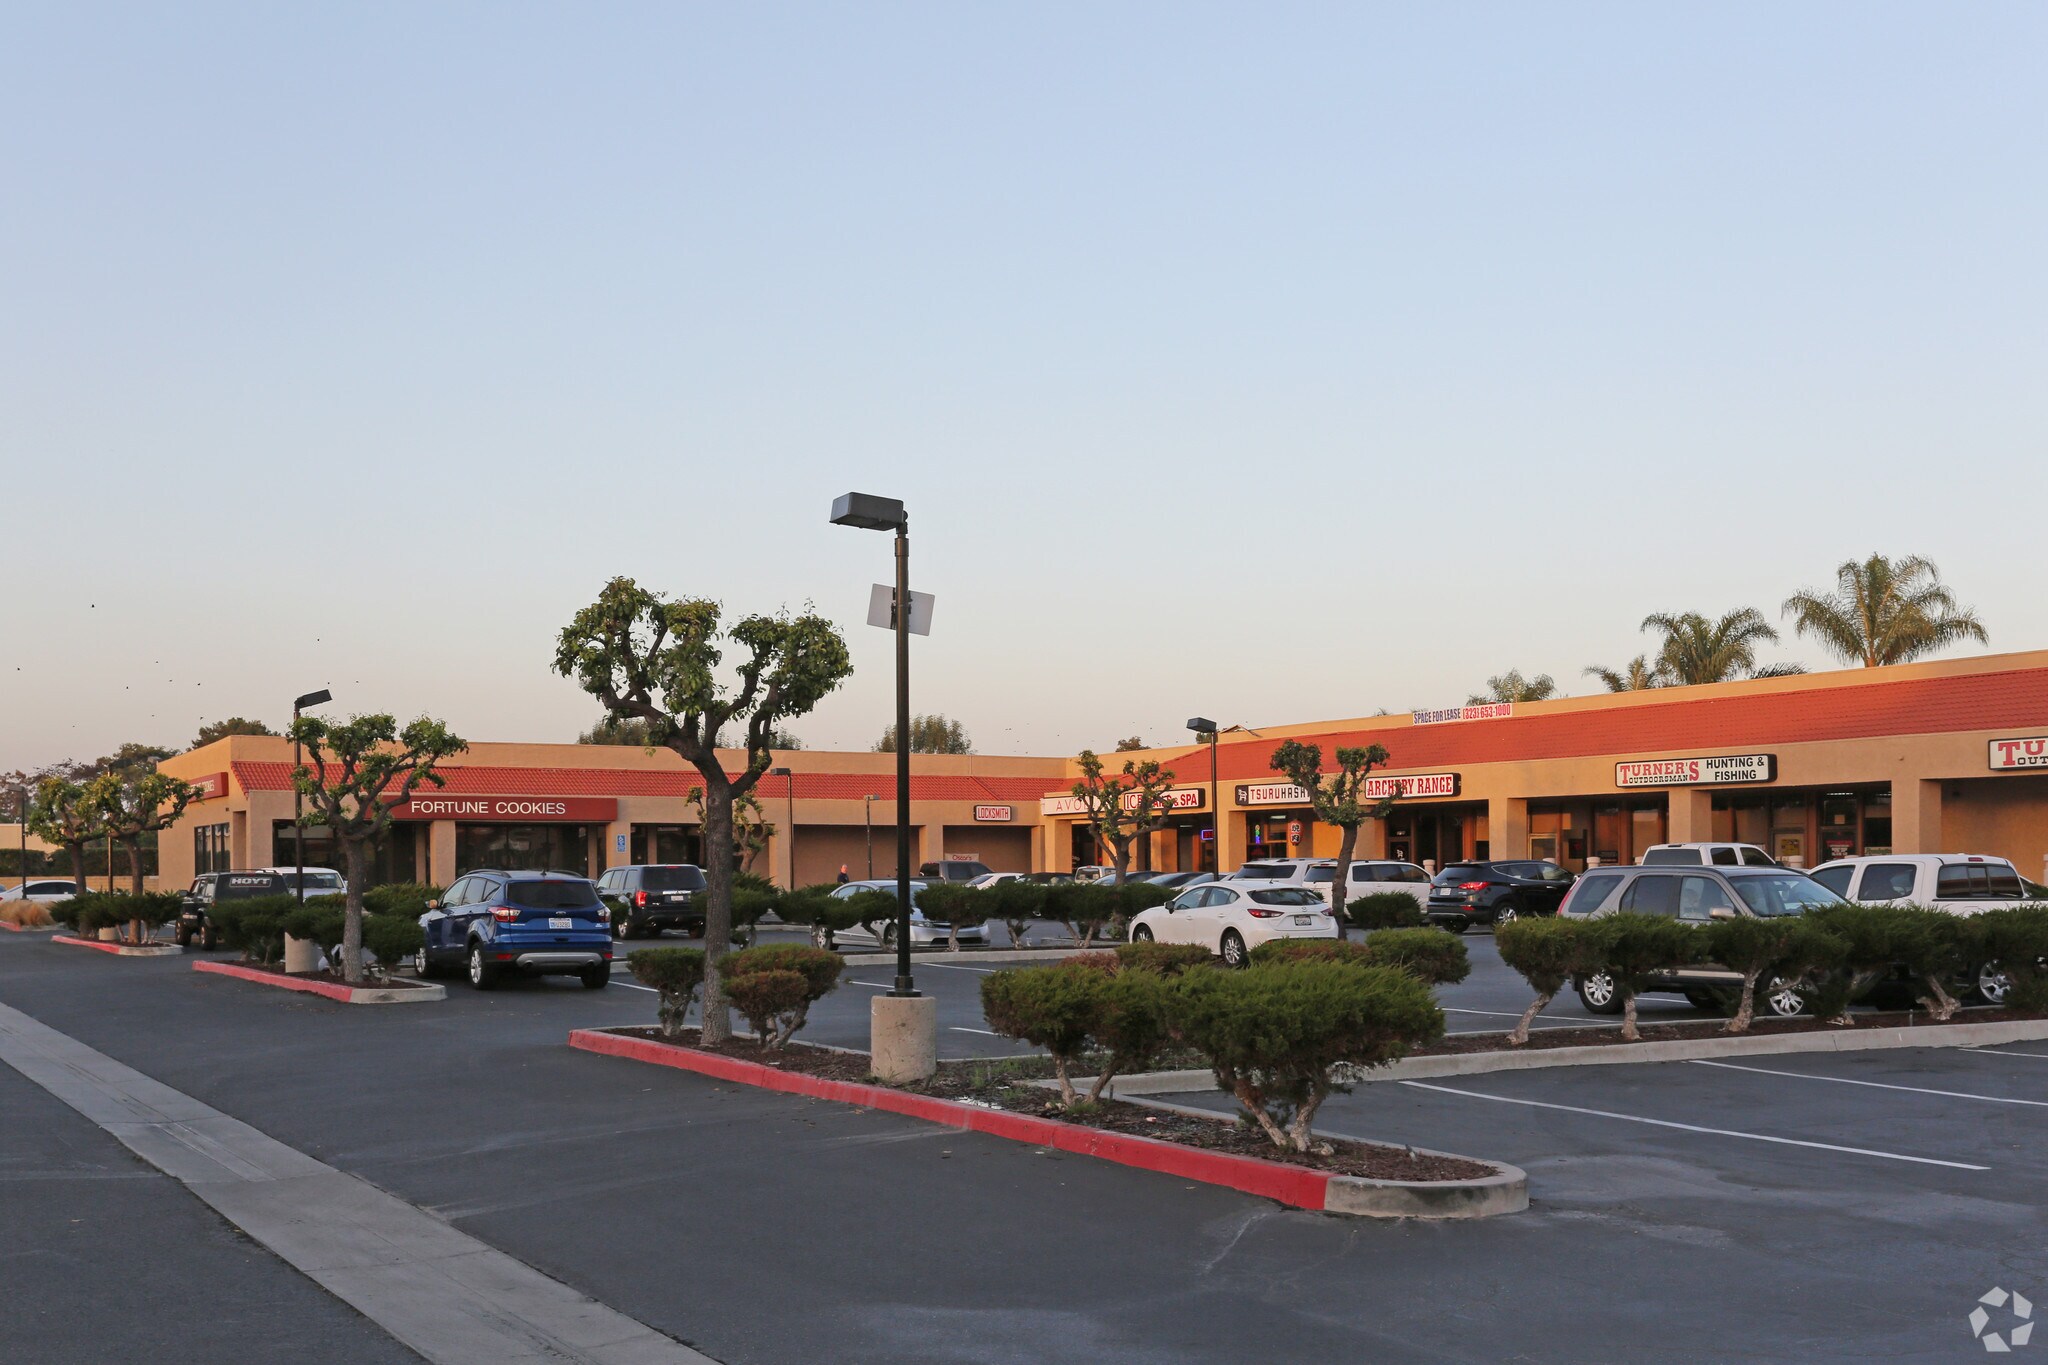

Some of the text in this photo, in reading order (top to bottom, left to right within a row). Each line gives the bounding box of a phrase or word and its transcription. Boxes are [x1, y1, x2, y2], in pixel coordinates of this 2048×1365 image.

[1414, 711, 1432, 724] SPACE
[1433, 710, 1444, 722] FOR
[1444, 708, 1461, 720] LEASE
[1480, 704, 1511, 718] 653-1000
[1706, 756, 1765, 769] HUNTING &
[1620, 761, 1699, 784] TURNER'S
[1628, 774, 1688, 784] OUTDOORSMAN
[1714, 769, 1757, 781] FISHING
[1417, 776, 1452, 793] RANGE
[1180, 793, 1198, 806] SPA
[411, 801, 566, 815] FORTUNE COOKIES
[978, 808, 1008, 818] LOCKSMITH
[231, 877, 271, 885] HOYT
